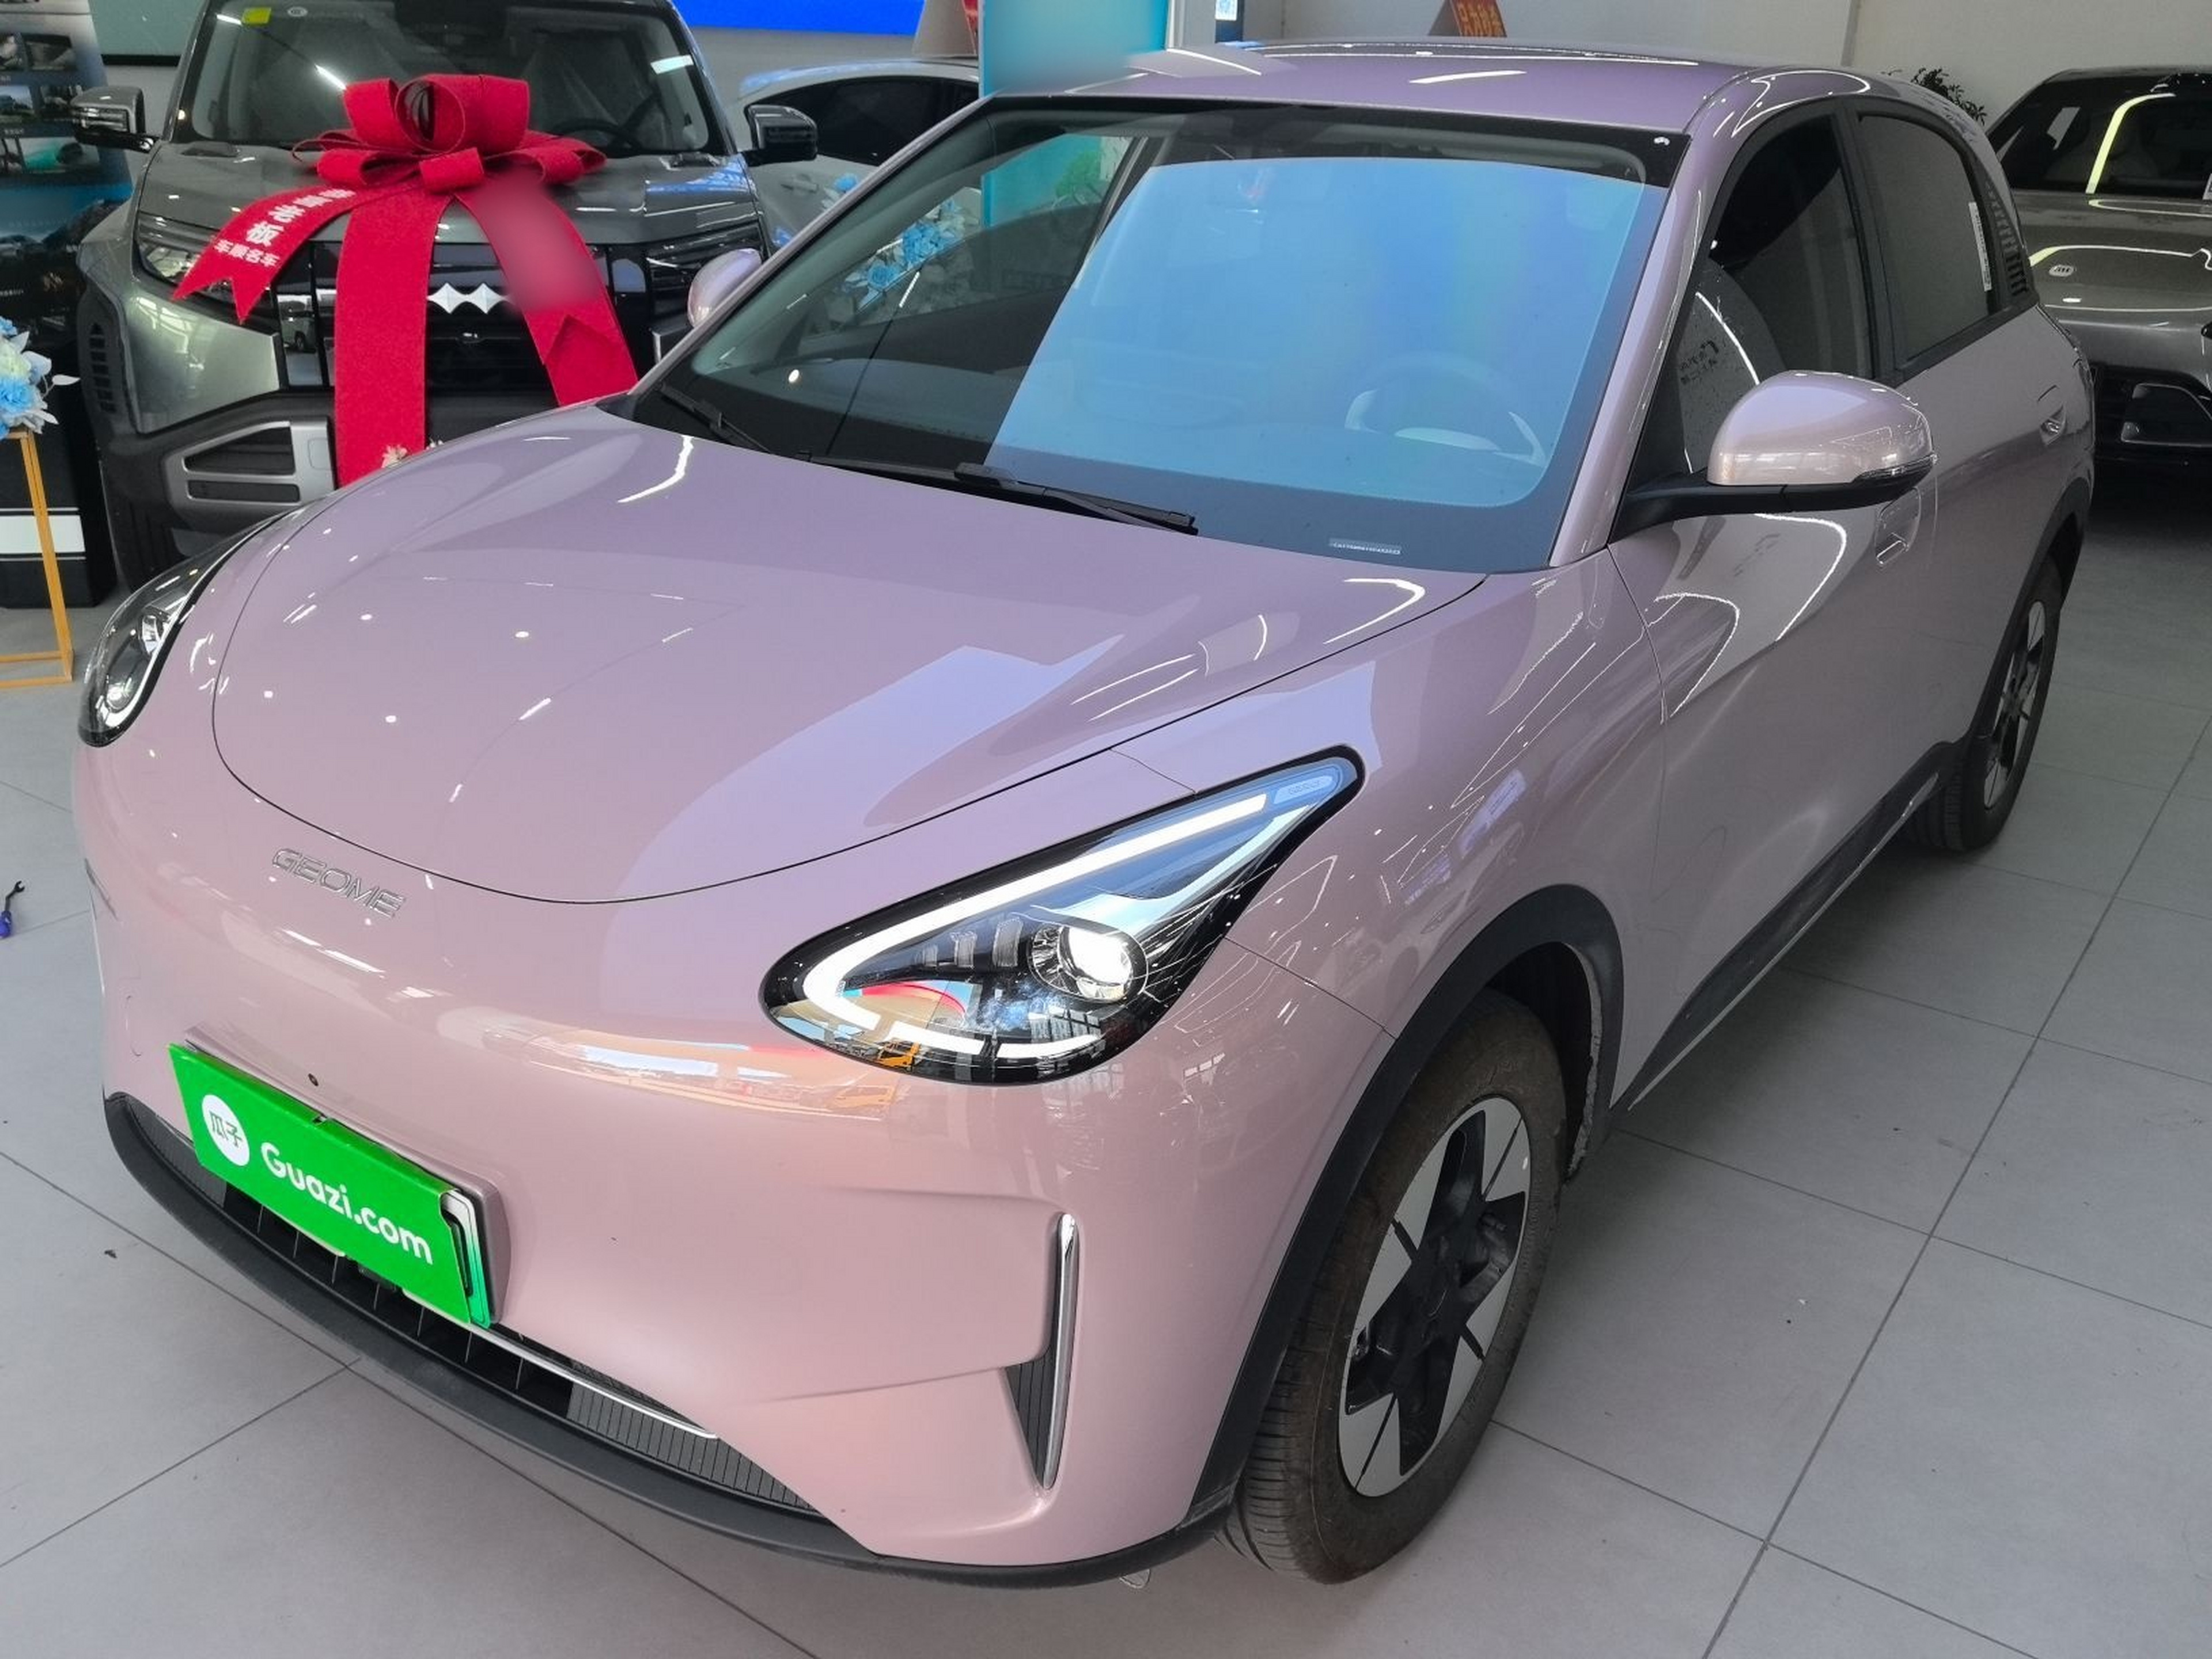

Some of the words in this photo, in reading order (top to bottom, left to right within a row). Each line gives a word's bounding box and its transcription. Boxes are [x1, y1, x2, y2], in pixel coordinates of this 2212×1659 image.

[272, 848, 406, 919] GEOME
[208, 1109, 243, 1148] 瓜子
[260, 1142, 433, 1265] Guazi.com
